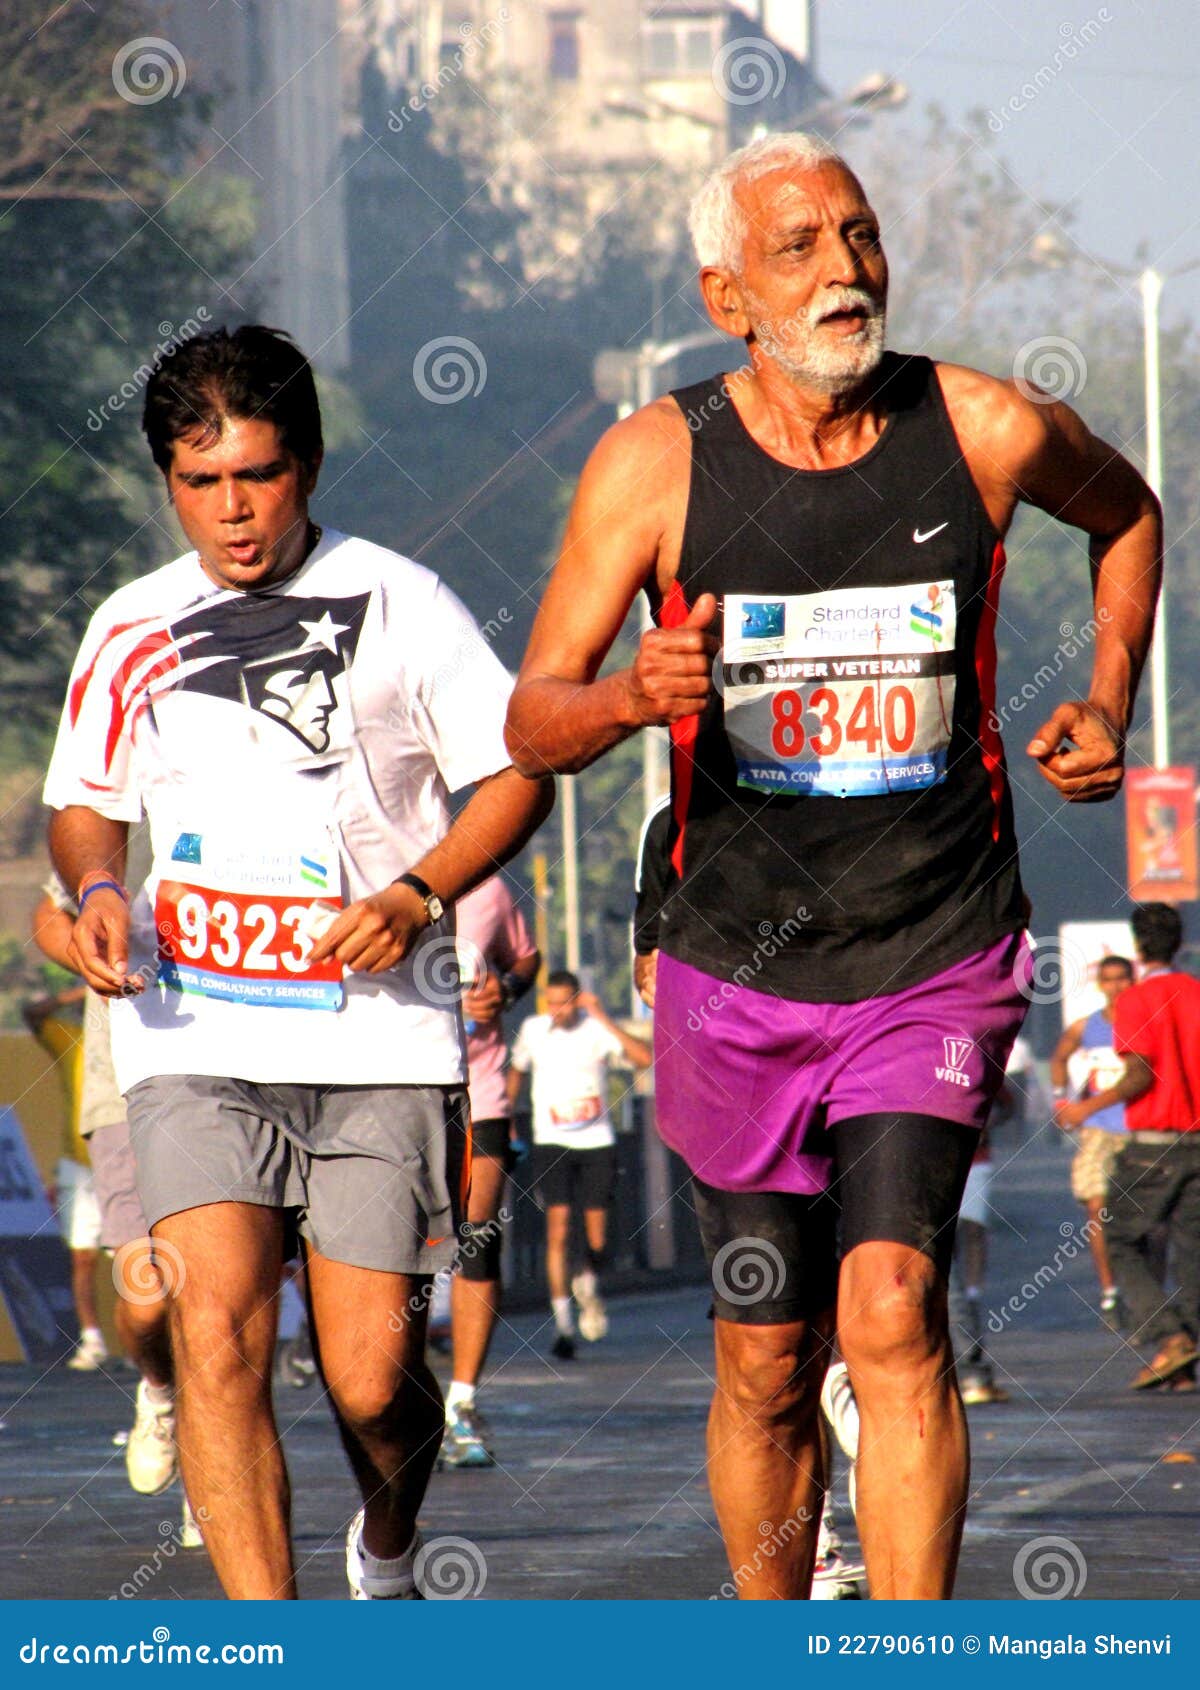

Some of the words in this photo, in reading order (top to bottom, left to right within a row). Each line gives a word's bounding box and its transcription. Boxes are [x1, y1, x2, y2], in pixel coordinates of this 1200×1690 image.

[812, 604, 901, 623] Standard
[765, 662, 828, 679] SUPER
[832, 659, 921, 676] VETERAN
[771, 685, 917, 759] 8340
[751, 769, 787, 783] TATA
[885, 762, 935, 780] SERVICES
[176, 893, 314, 973] 9323
[171, 970, 199, 986] TATA
[201, 977, 273, 997] CONSULTANCY
[276, 986, 326, 999] SERVICES
